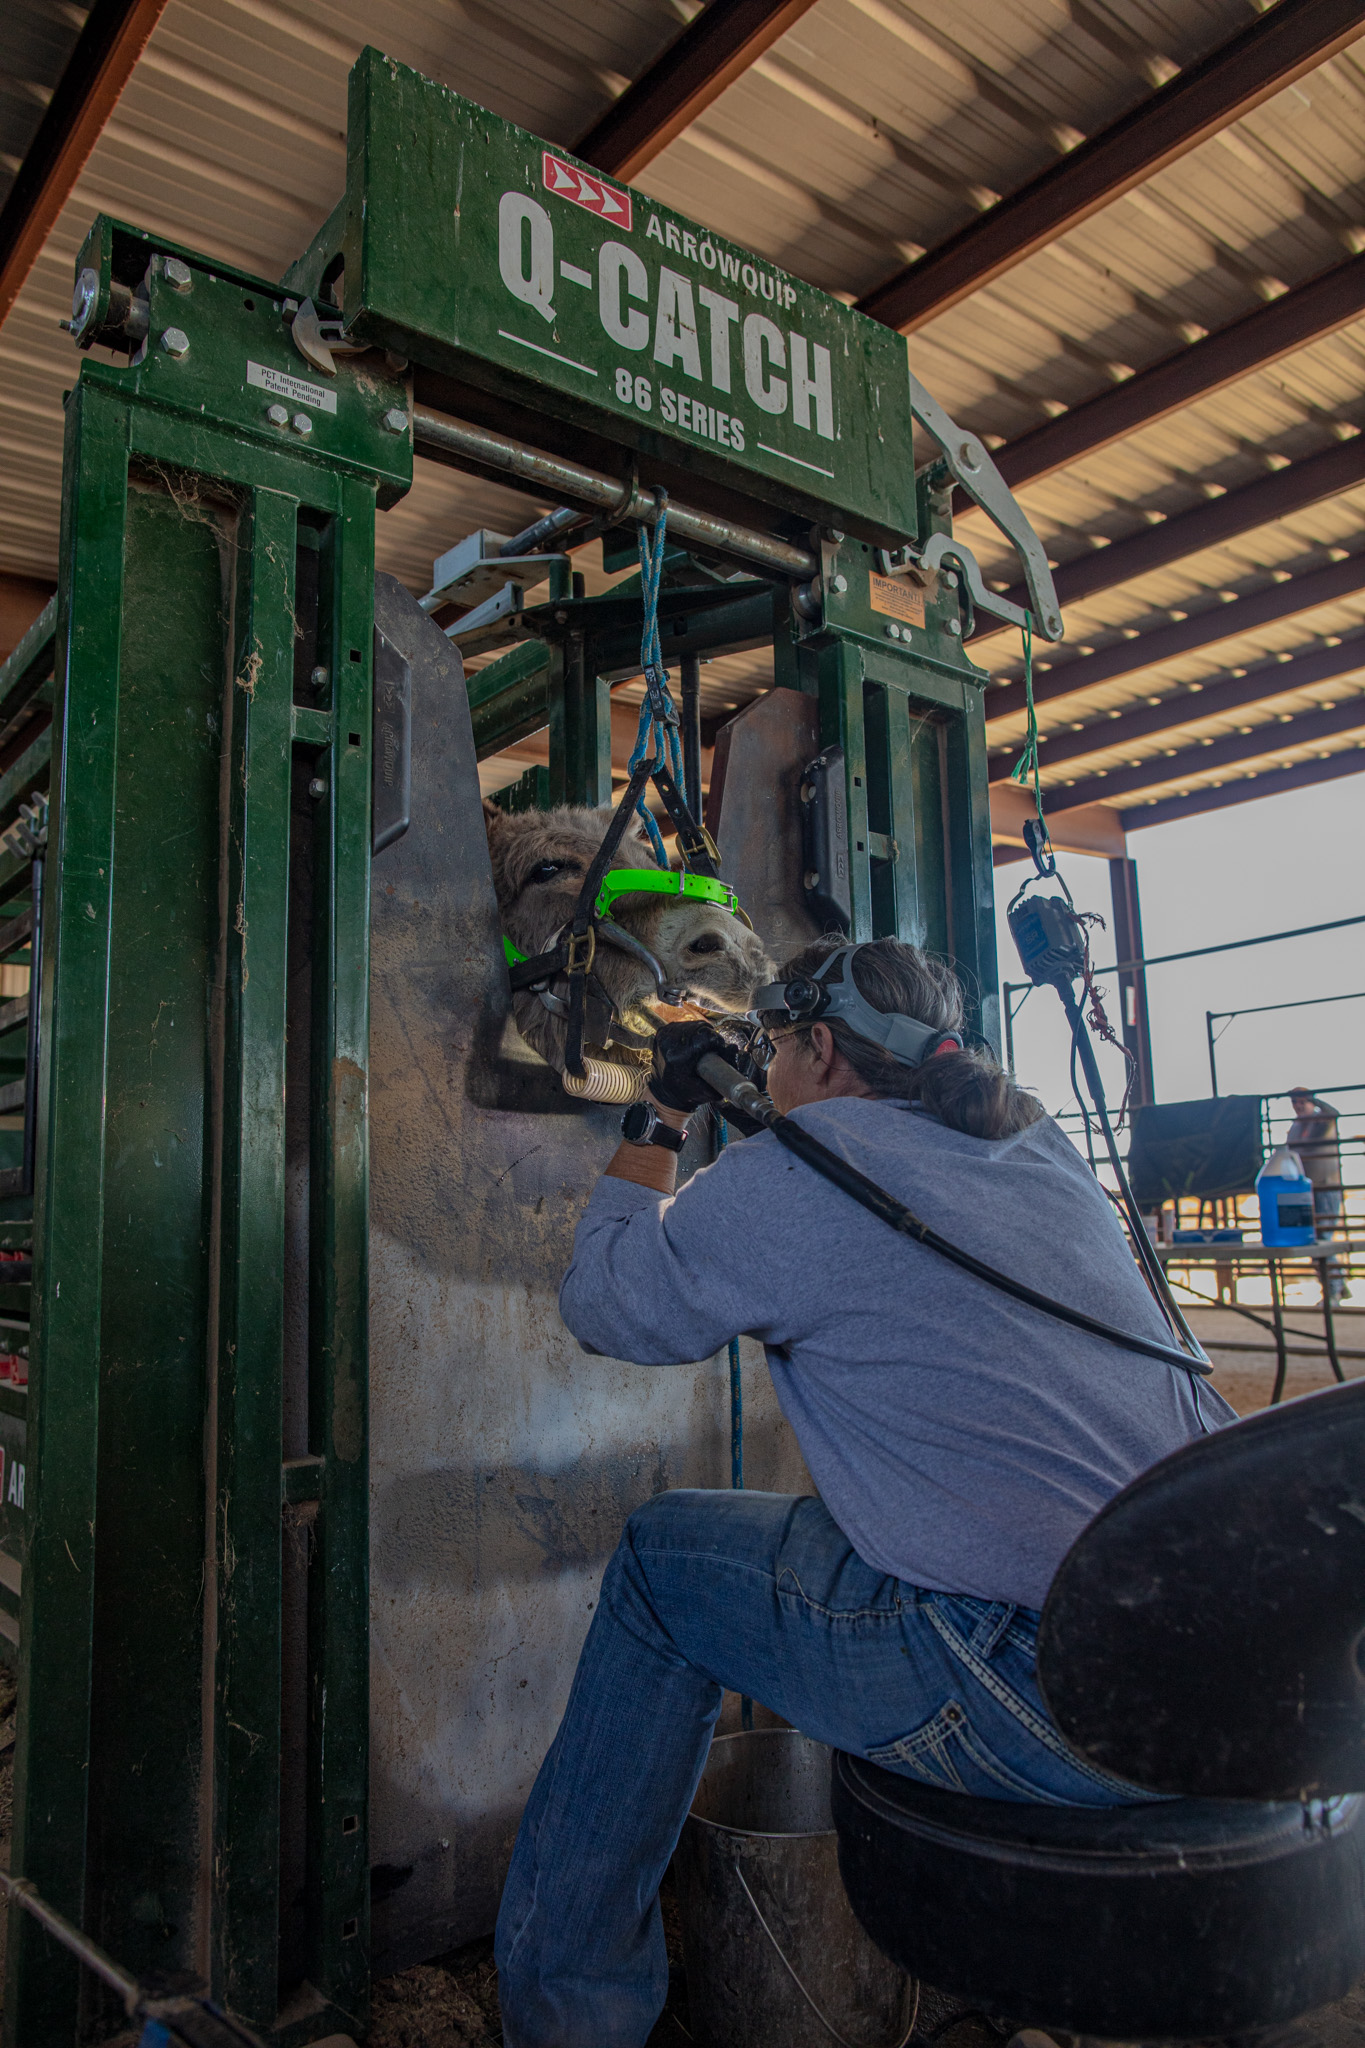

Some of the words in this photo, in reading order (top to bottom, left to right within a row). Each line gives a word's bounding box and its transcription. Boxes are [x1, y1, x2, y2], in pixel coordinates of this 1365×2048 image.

[645, 213, 797, 311] ARROWQUIP
[498, 190, 835, 442] Q-CATCH
[261, 368, 277, 380] PCT
[280, 375, 325, 398] International
[265, 379, 289, 395] Patent
[292, 388, 321, 407] Pending
[614, 367, 652, 412] 86
[659, 387, 746, 452] SERIES
